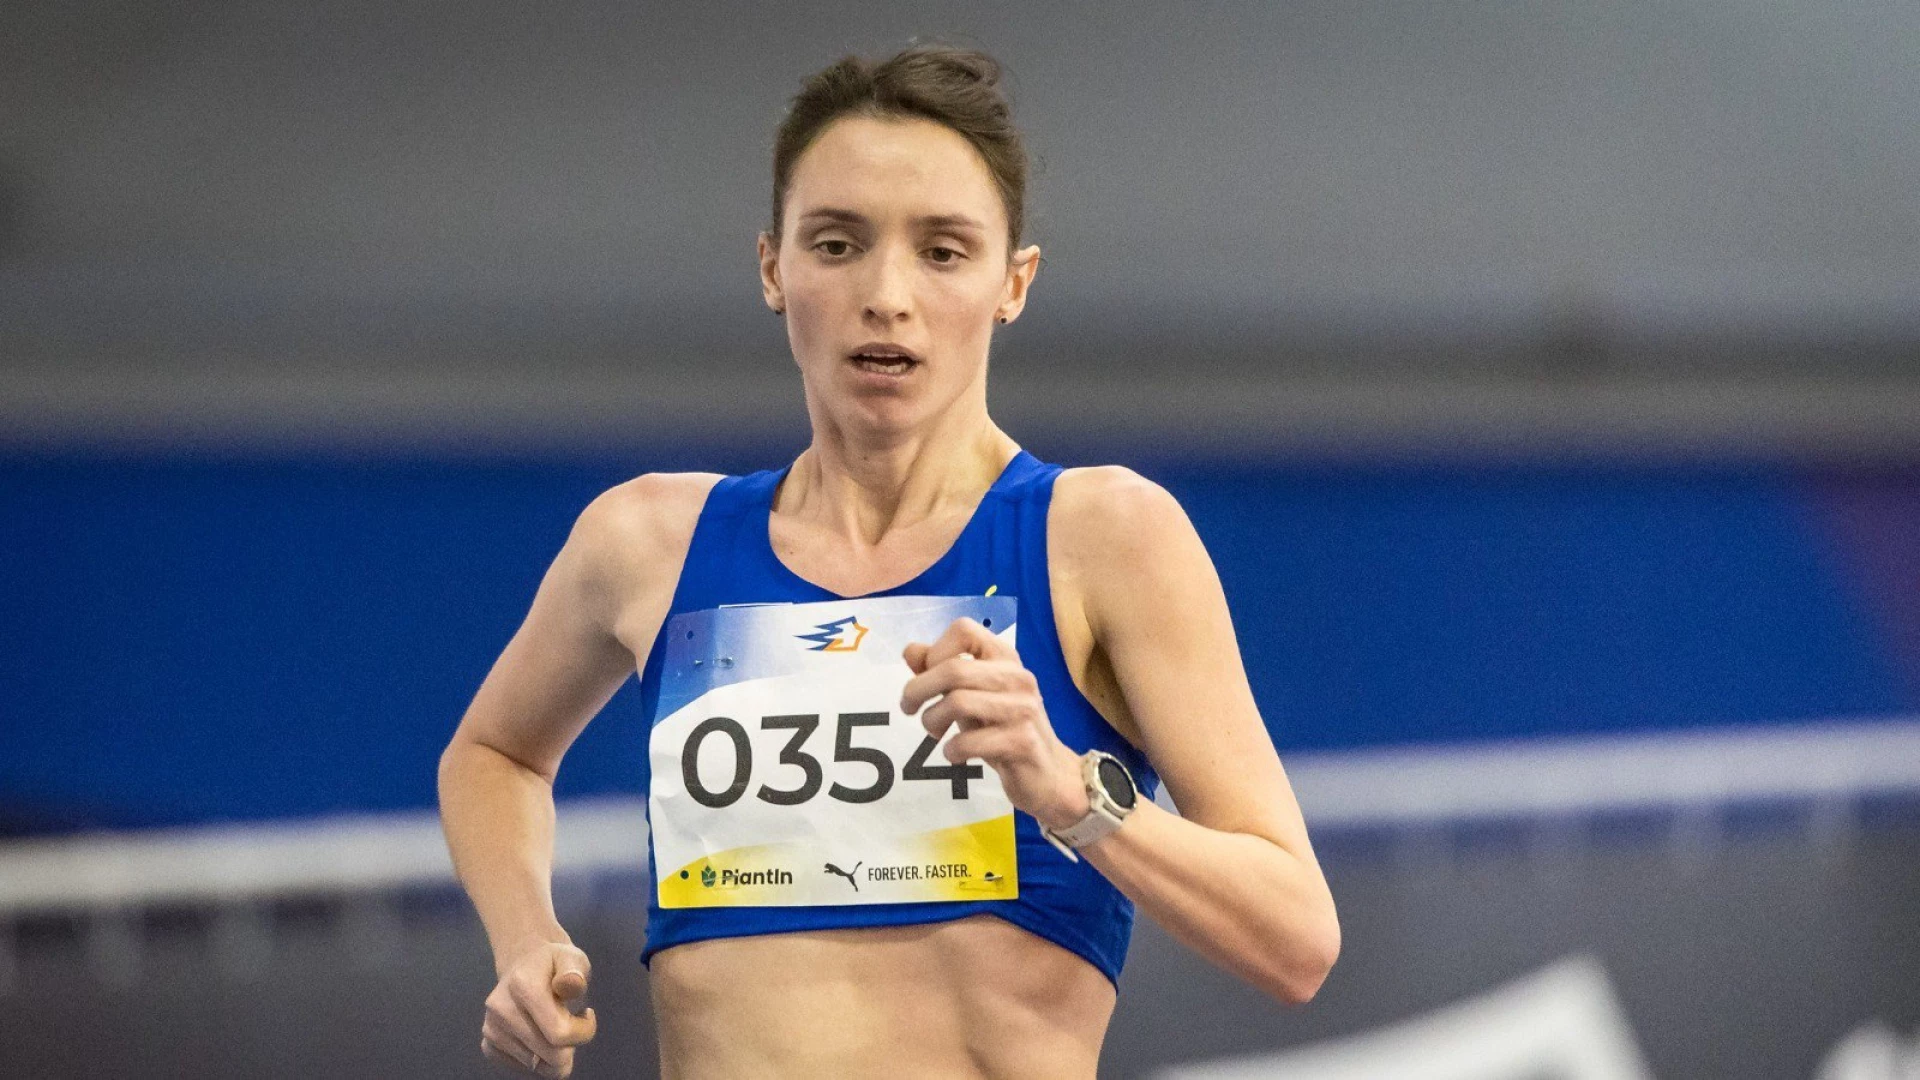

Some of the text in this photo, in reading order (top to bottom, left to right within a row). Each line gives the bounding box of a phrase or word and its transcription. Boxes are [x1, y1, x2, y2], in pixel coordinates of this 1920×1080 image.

[681, 711, 984, 809] 0354
[868, 863, 972, 881] FOREVER. FASTER.
